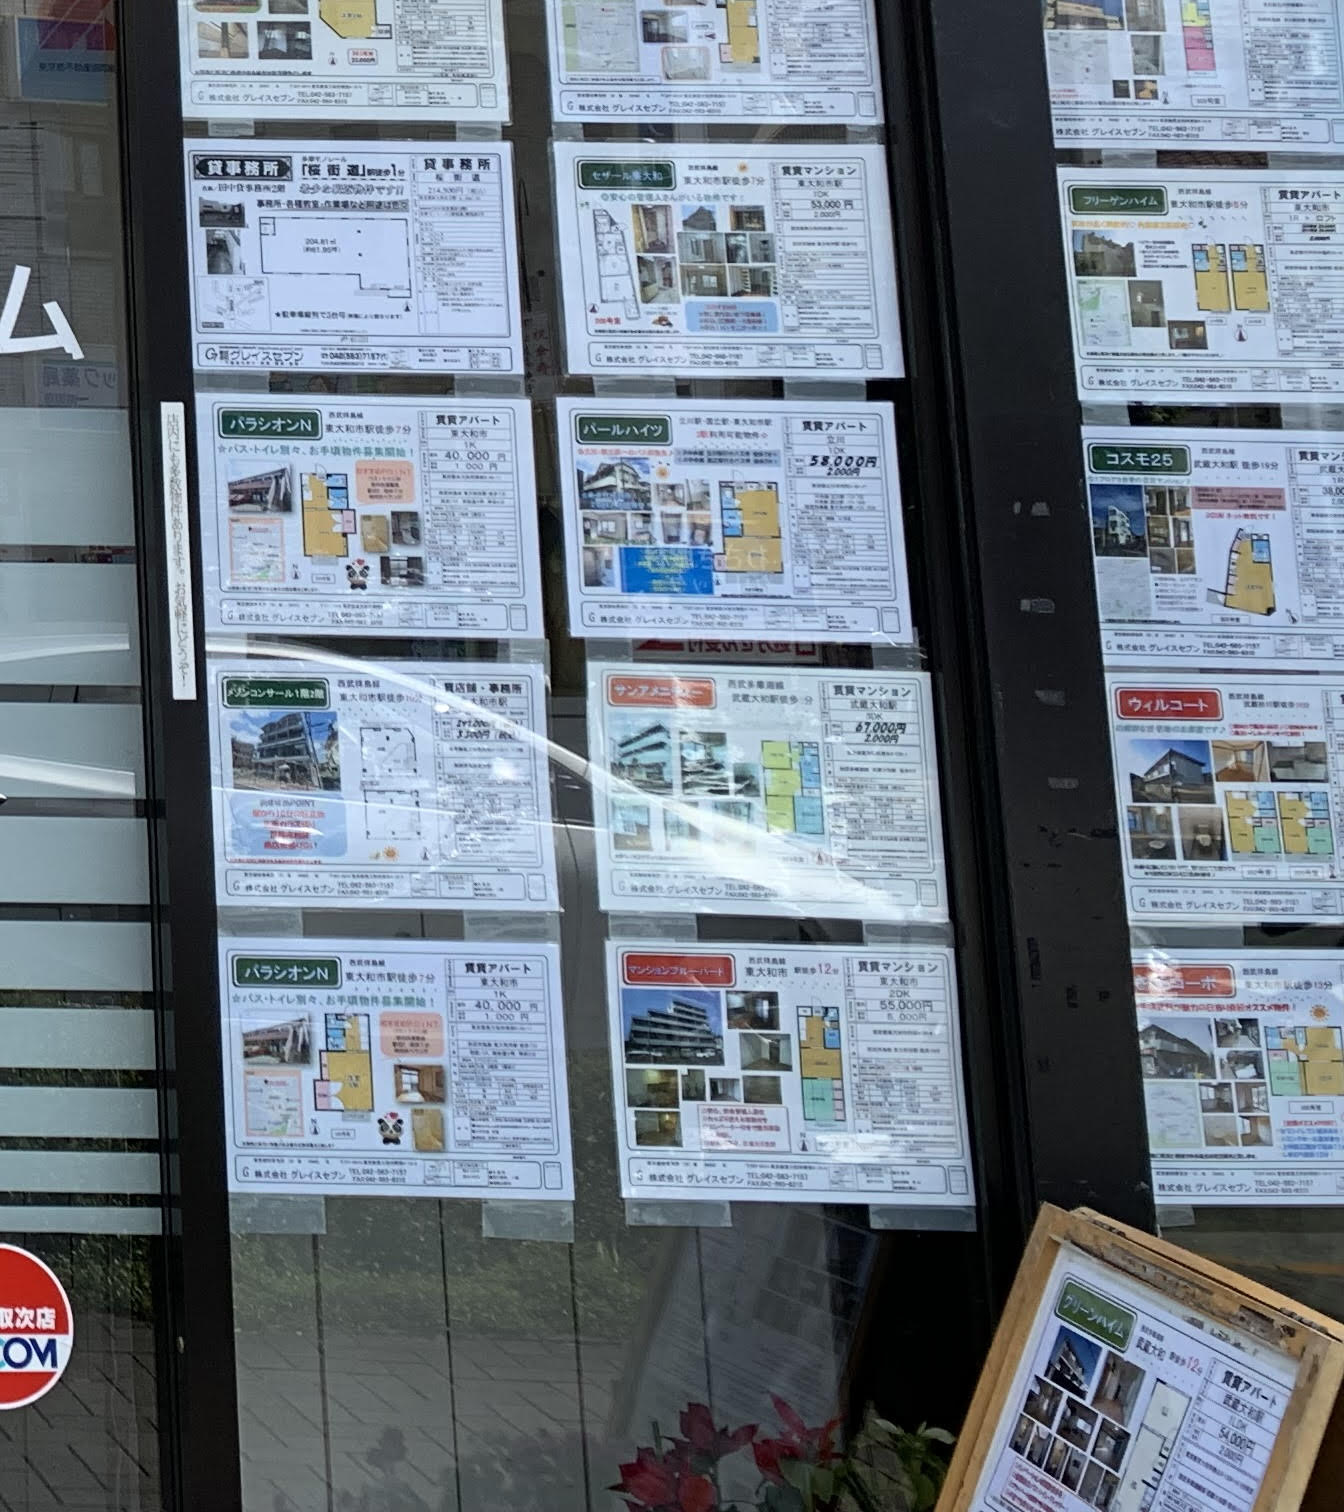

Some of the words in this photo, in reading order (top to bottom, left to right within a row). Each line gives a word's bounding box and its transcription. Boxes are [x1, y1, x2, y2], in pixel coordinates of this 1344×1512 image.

[207, 160, 279, 176] 貸事務所
[228, 351, 304, 361] グレイスセブン
[230, 417, 312, 432] パラシオンN
[583, 422, 663, 437] パールハイツ
[1106, 453, 1173, 466] コスモ25
[1128, 698, 1208, 711] ウィルコート
[244, 966, 329, 981] パラシオンN
